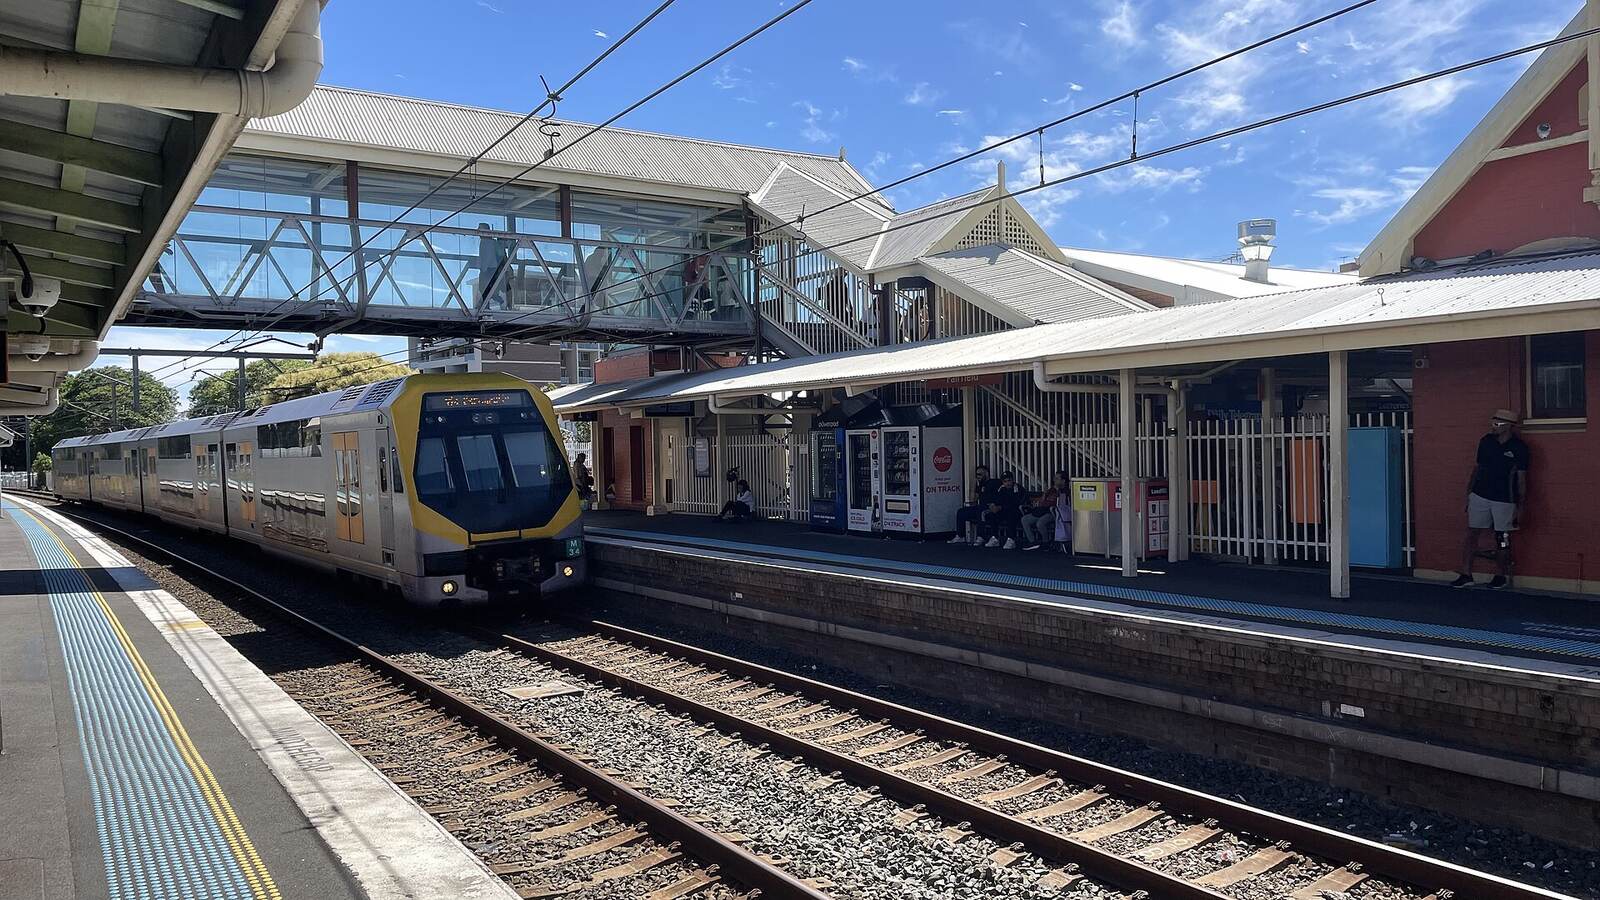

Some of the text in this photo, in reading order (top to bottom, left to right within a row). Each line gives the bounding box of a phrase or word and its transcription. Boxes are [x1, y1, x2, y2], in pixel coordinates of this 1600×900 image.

[926, 485, 961, 494] ON TRACK
[570, 539, 578, 547] M
[283, 743, 320, 758] THE
[296, 757, 334, 772] GAP
